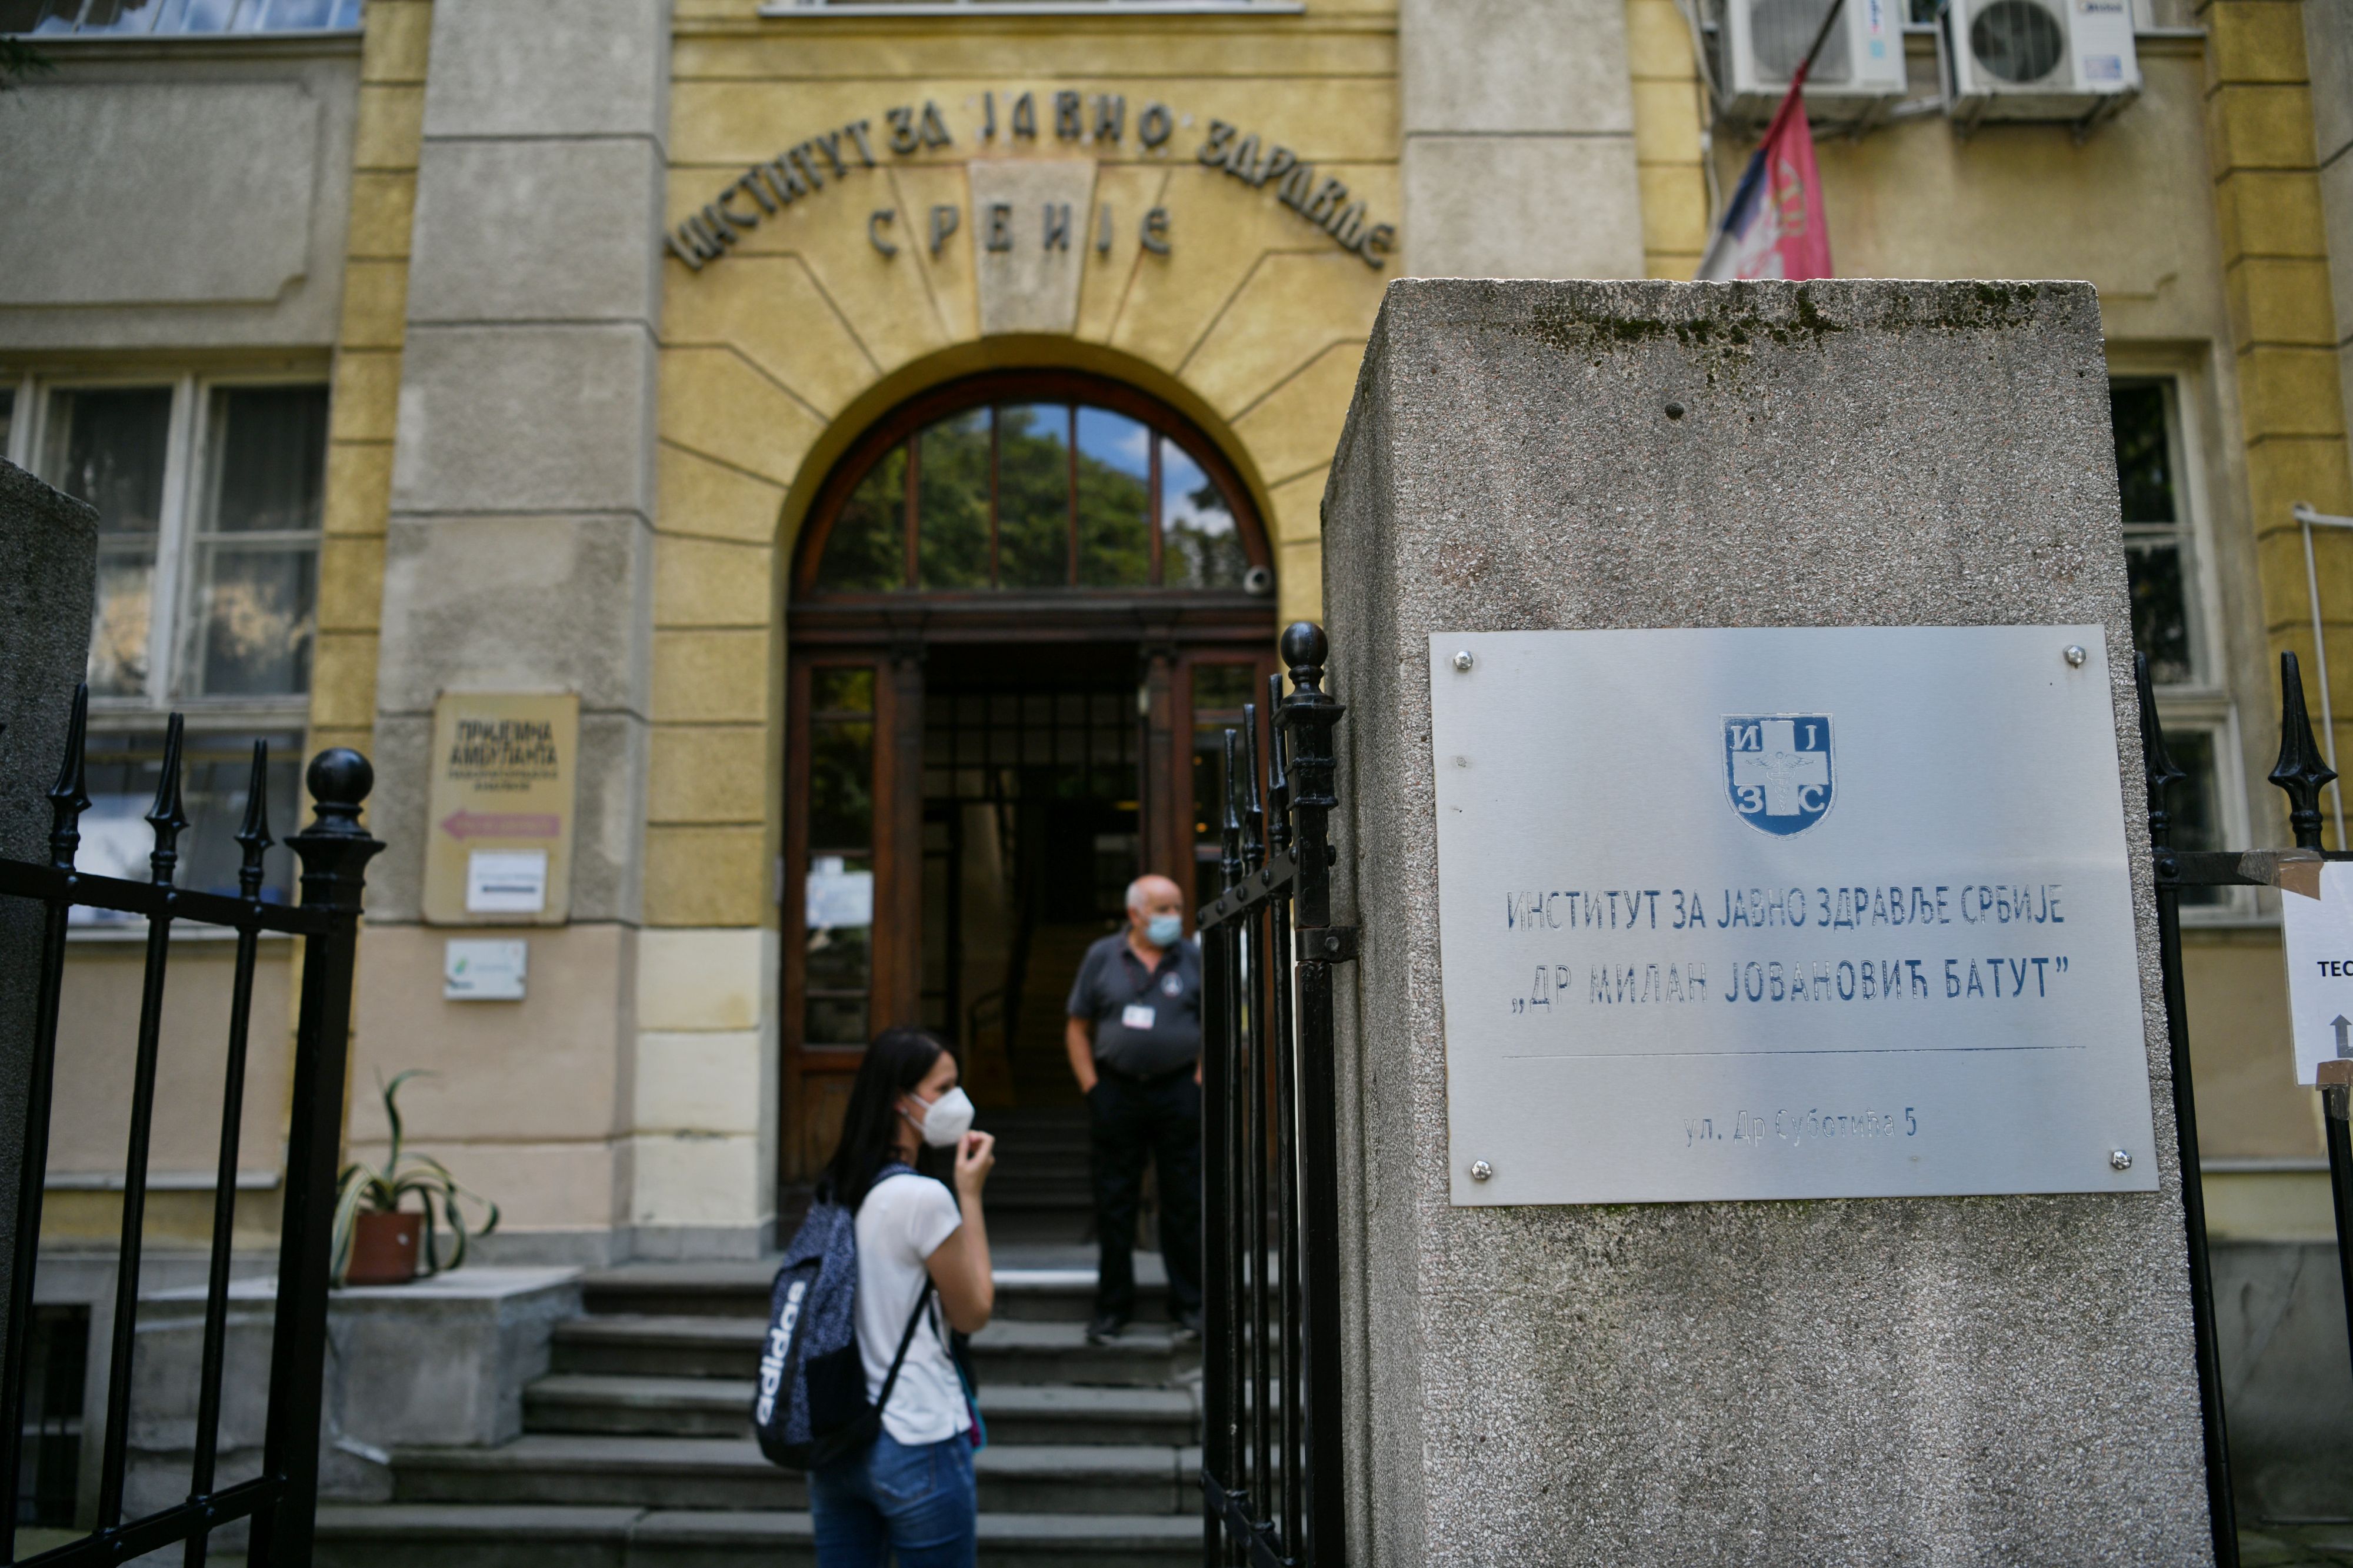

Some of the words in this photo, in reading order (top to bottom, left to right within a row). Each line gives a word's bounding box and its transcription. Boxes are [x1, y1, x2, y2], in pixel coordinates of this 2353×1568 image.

[665, 121, 876, 271] ИНСТИТУТ
[886, 99, 952, 154] ЗА
[982, 90, 1174, 147] ЈАВНО
[1507, 889, 1661, 932] ИНСТИТУТ
[1672, 889, 1707, 929] ЗА
[1717, 887, 1807, 929] ЈАВНО
[1817, 886, 1952, 934] ЗДРАВЉЕ
[1961, 884, 2065, 925] СРБИЈЕ
[1589, 962, 1706, 1004] МИЛАН
[1725, 959, 1928, 1002] ЈОВАНОВИЋ
[1684, 1118, 1722, 1148] ул.
[1734, 1110, 1765, 1147] Др
[1775, 1107, 1895, 1147] Суботића
[1905, 1107, 1917, 1136] 5
[756, 1280, 806, 1427] adidas
